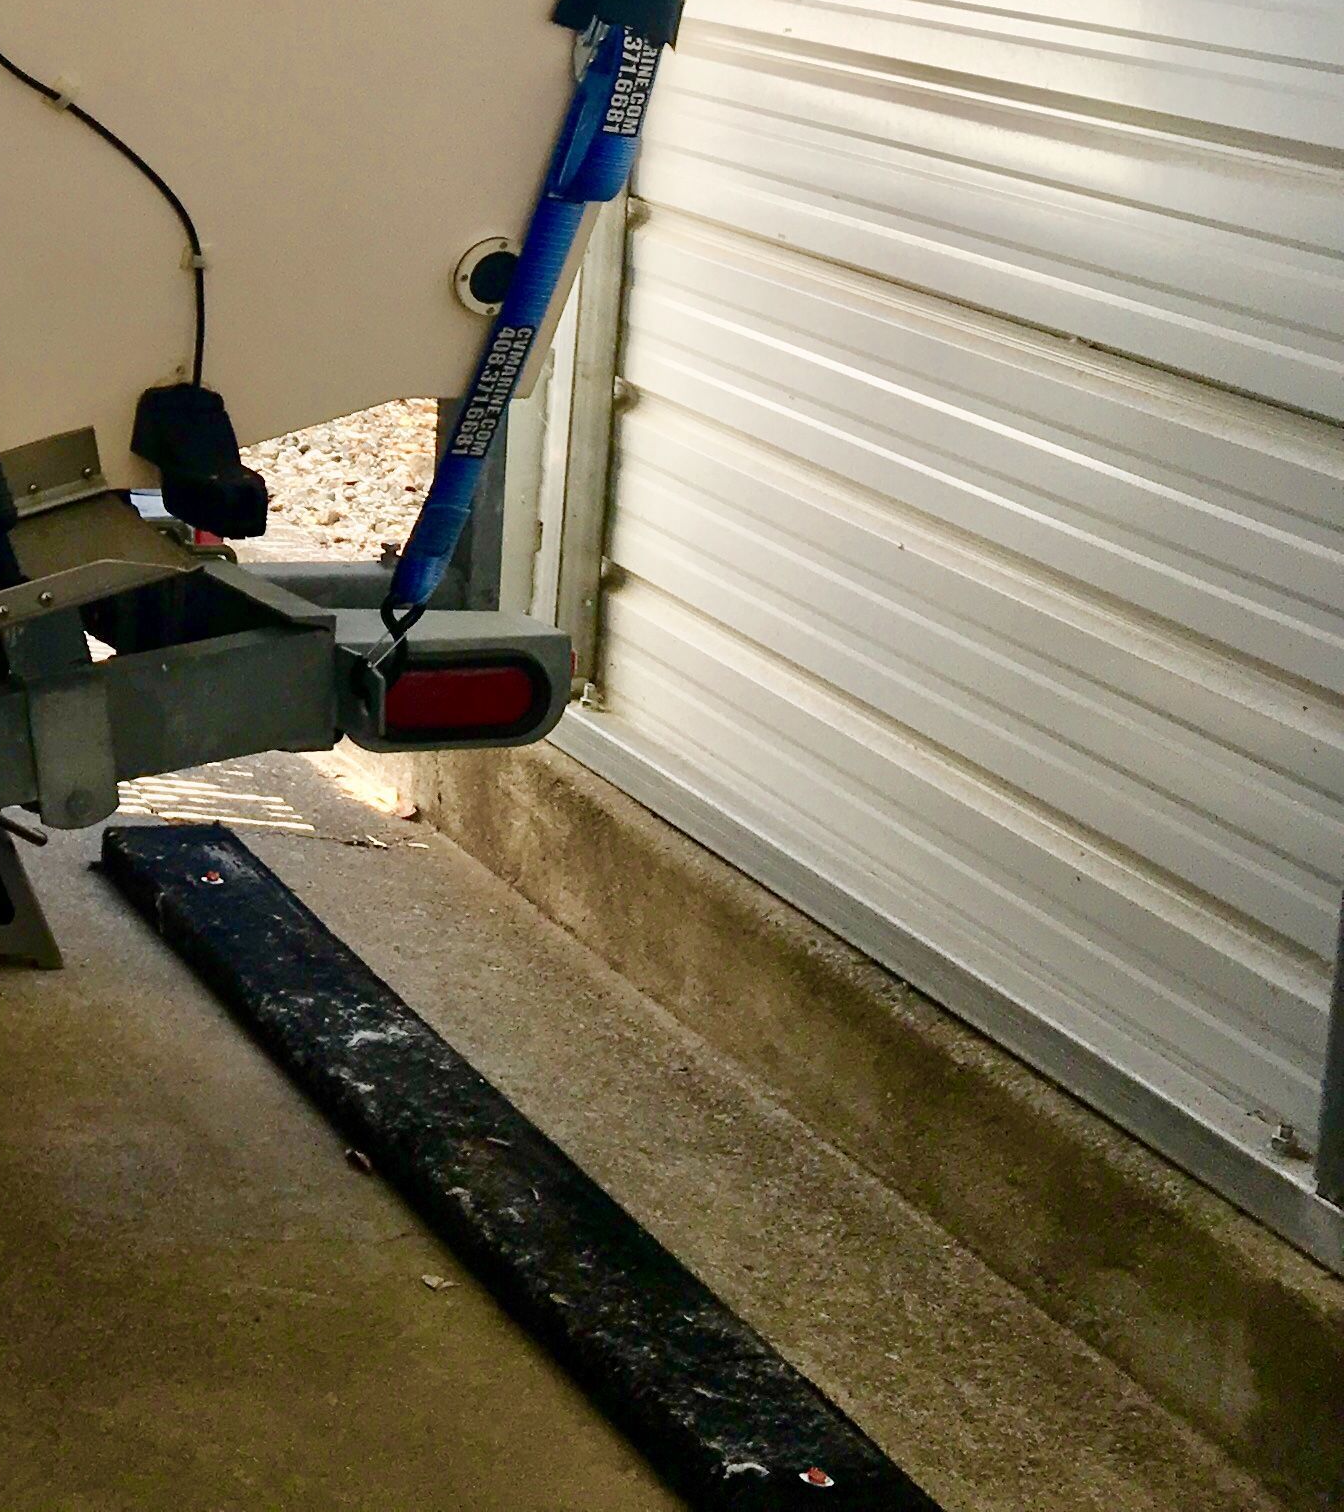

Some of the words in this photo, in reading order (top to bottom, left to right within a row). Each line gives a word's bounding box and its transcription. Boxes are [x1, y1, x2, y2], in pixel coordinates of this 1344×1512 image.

[602, 25, 643, 134] .371.6681
[620, 35, 659, 136] RINE.COM
[451, 326, 516, 455] 408.371.6681
[468, 327, 533, 456] CVMARINE.COM
